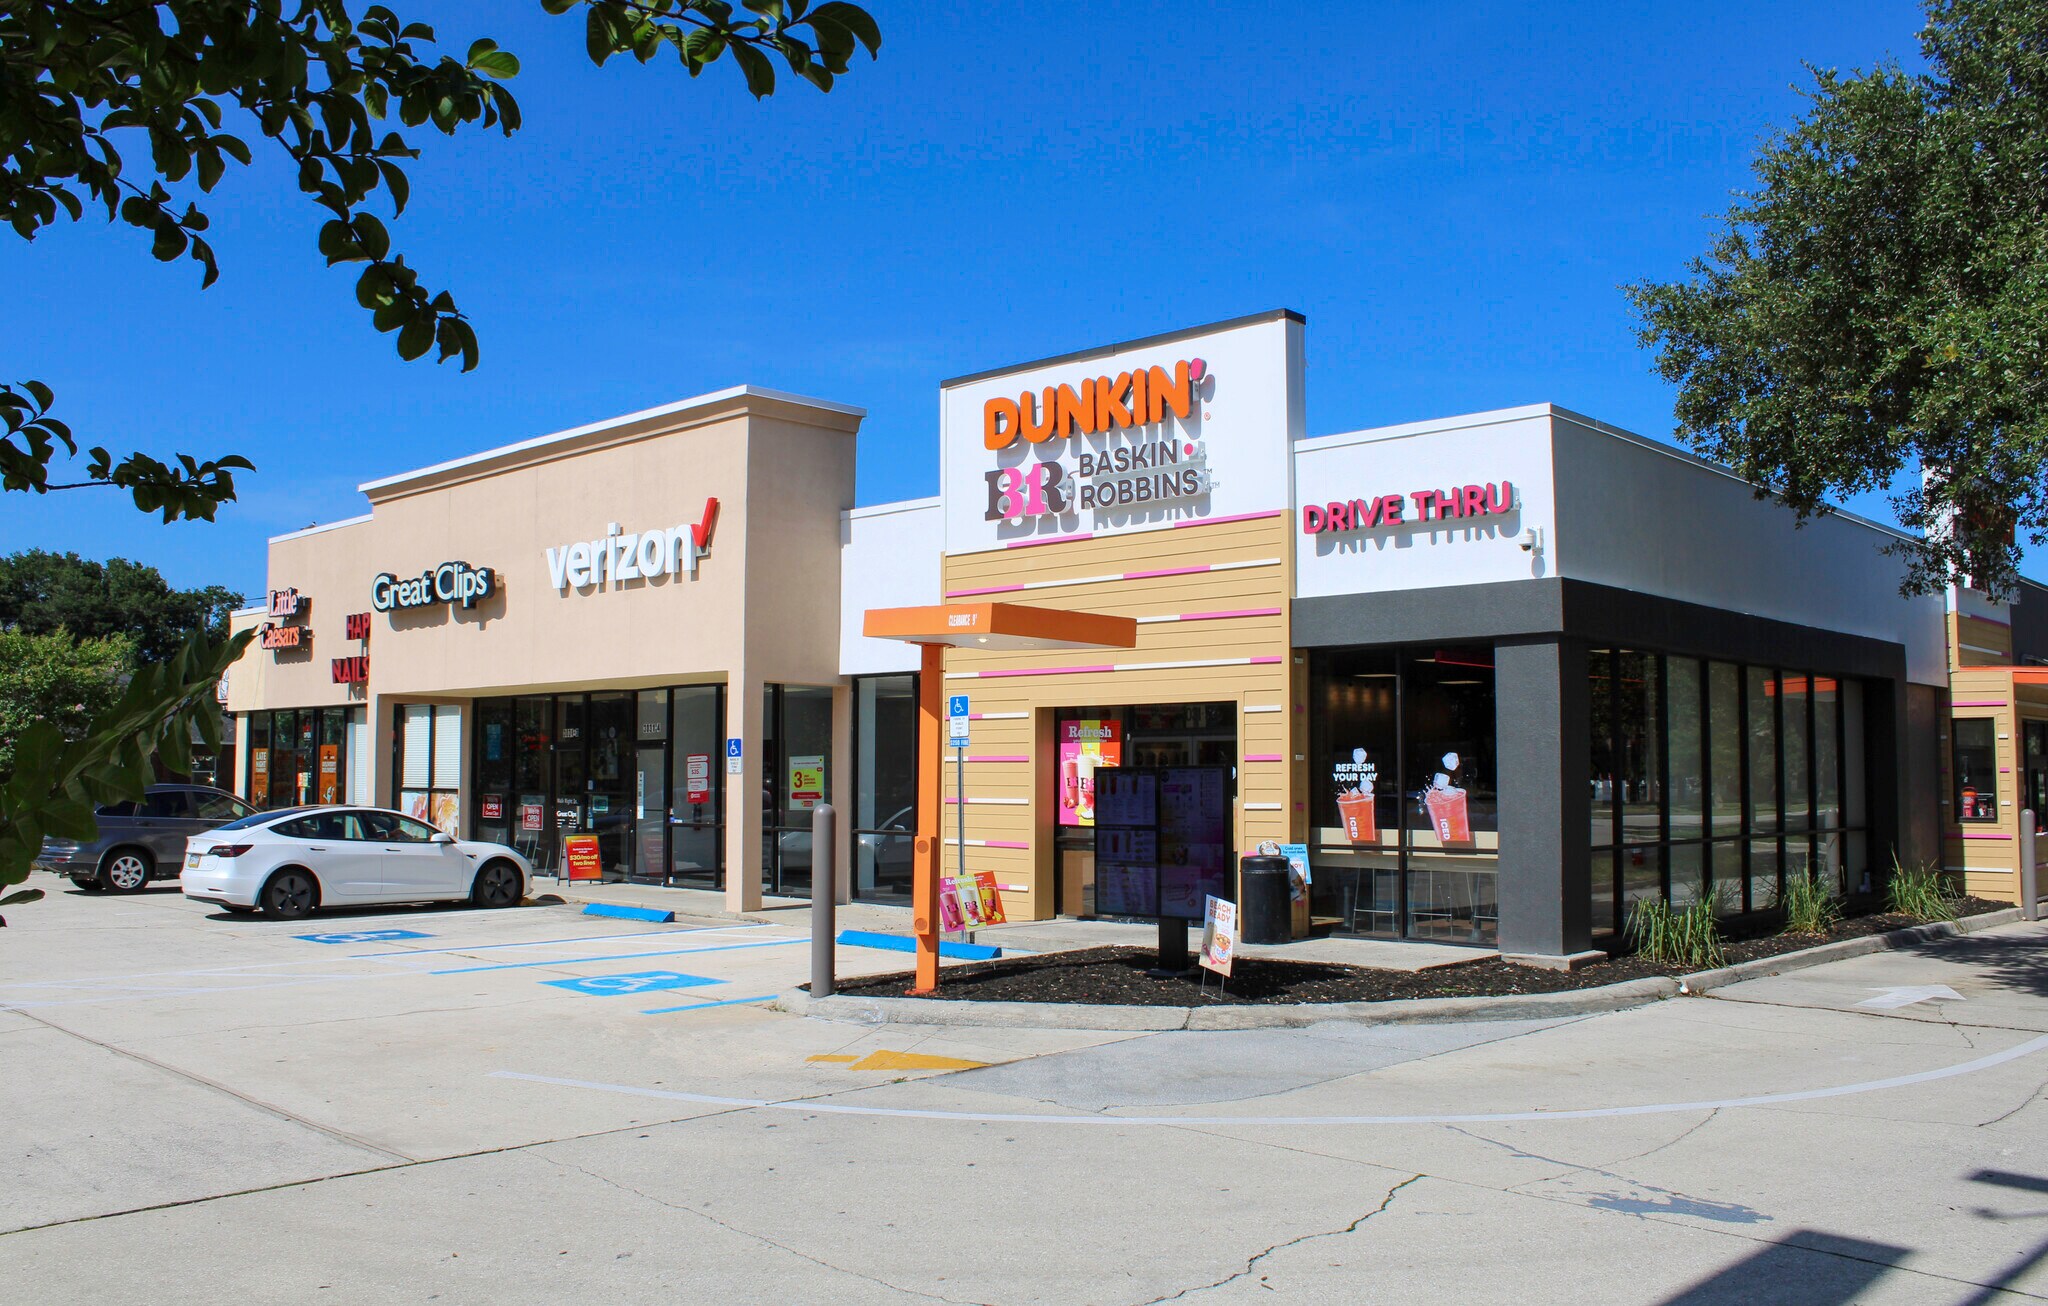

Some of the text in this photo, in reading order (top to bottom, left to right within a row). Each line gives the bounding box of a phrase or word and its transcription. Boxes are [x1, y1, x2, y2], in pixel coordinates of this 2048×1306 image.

[983, 357, 1207, 451] DUNKIN'
[1079, 438, 1178, 478] BASKIN
[1080, 468, 1198, 510] ROBBINS
[1302, 481, 1515, 535] DRIVE THRU
[545, 521, 697, 590] verizon
[372, 561, 488, 611] Great Clips
[269, 588, 298, 617] Little
[260, 623, 300, 649] Caesars
[332, 656, 370, 684] NAILS
[1069, 726, 1112, 738] Refresh
[793, 771, 803, 789] 3
[1333, 772, 1378, 782] YOUR DAY
[1335, 763, 1375, 773] REFRESH
[1349, 816, 1359, 839] ICED
[1439, 818, 1451, 840] ICED
[1208, 908, 1231, 923] READY
[1209, 899, 1232, 915] BEACH
